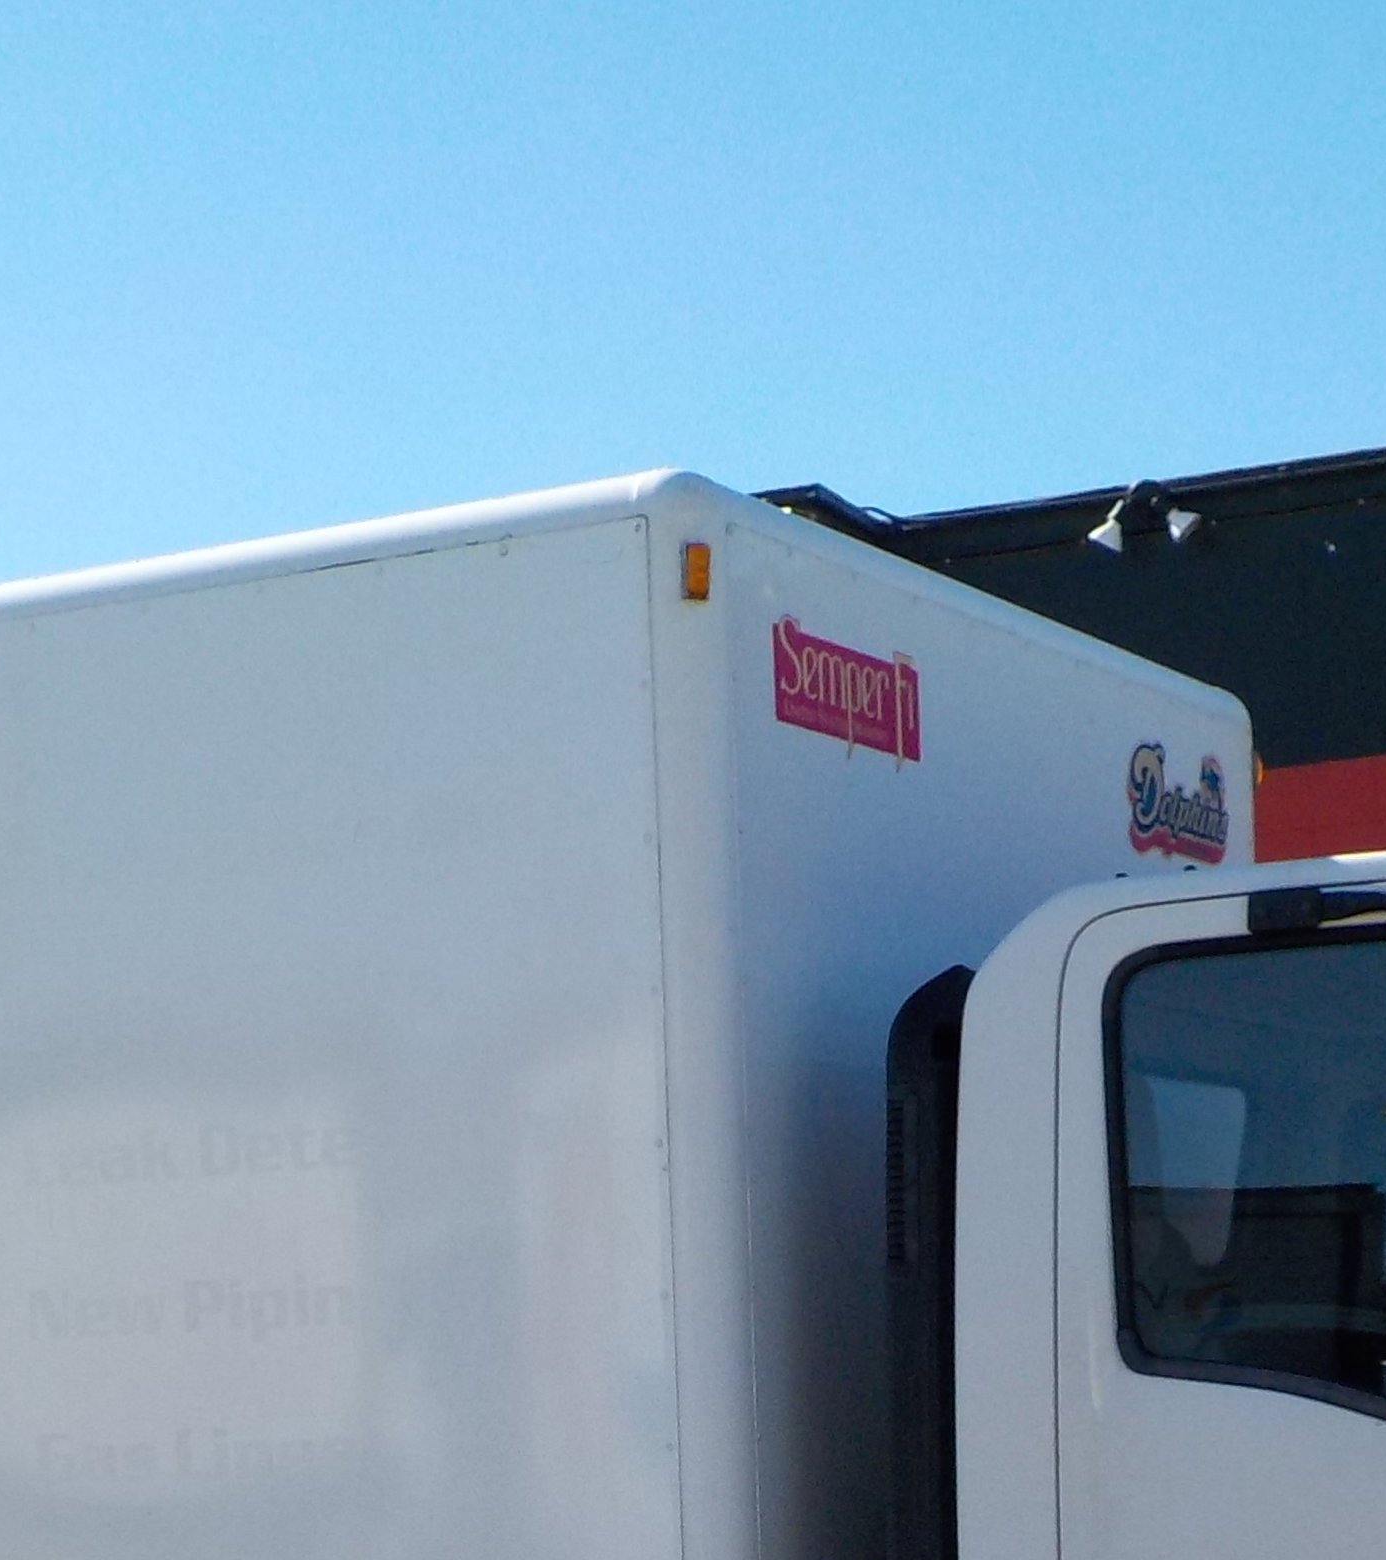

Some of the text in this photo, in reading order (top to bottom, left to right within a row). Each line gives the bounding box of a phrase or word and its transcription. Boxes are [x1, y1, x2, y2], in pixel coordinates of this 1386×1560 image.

[778, 614, 890, 759] Semper
[1130, 743, 1229, 844] Dolphins
[26, 1286, 166, 1341] New
